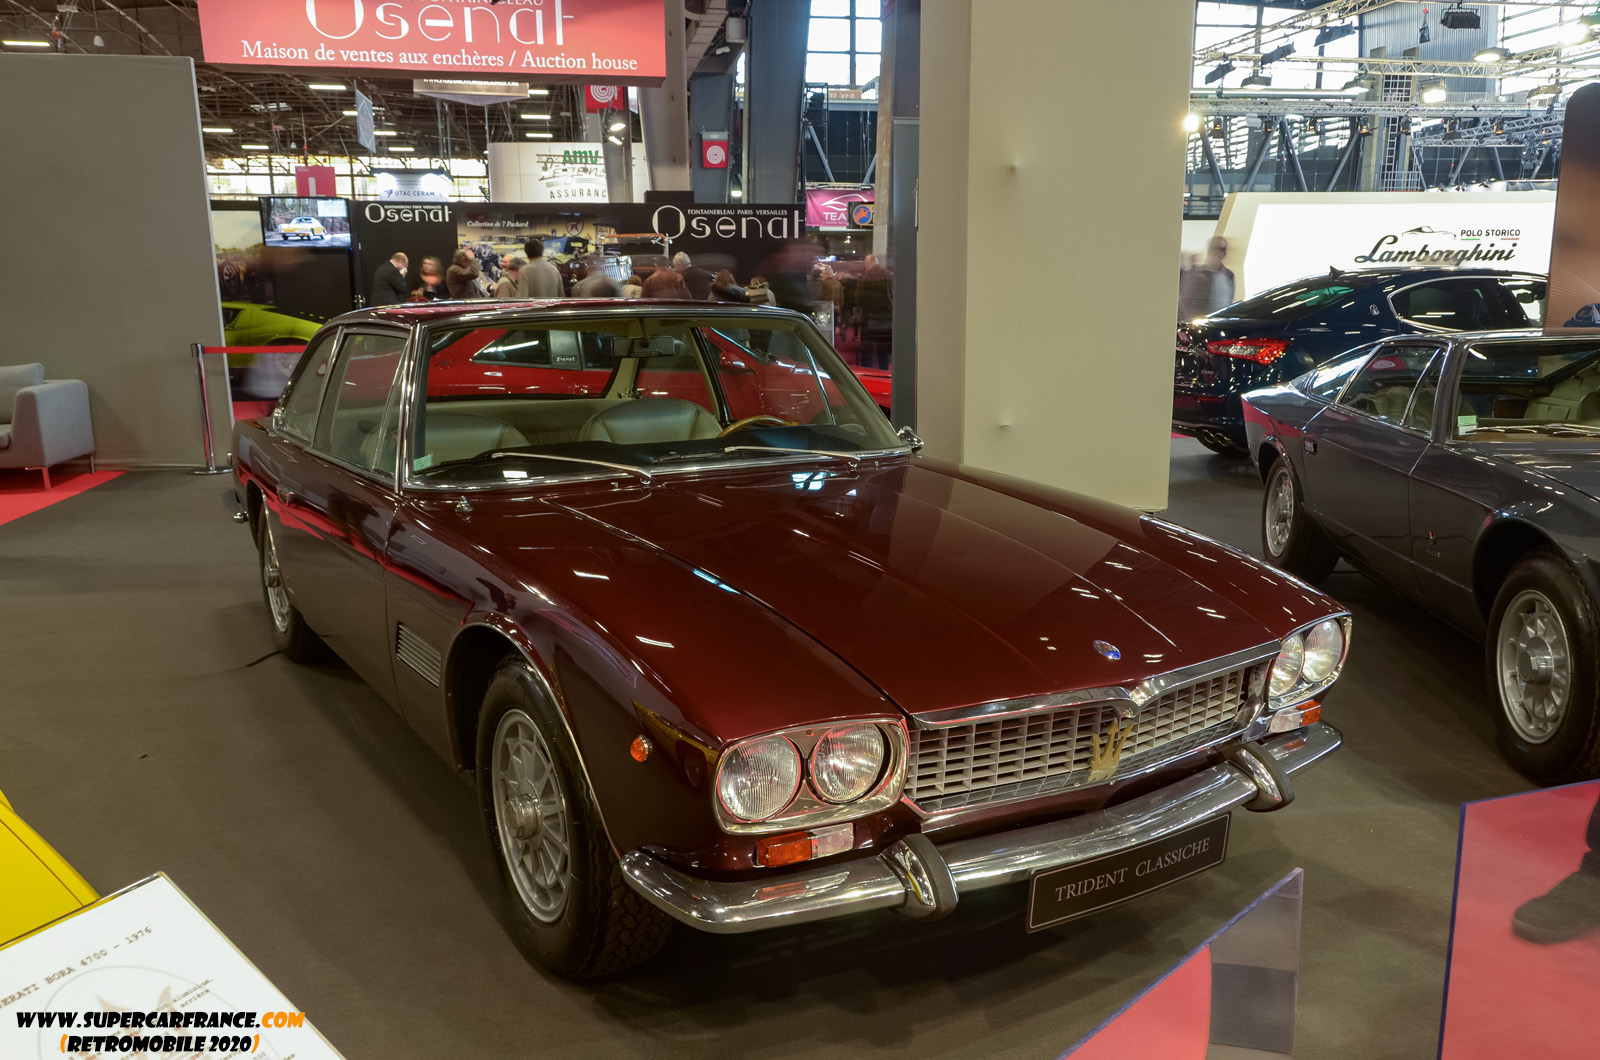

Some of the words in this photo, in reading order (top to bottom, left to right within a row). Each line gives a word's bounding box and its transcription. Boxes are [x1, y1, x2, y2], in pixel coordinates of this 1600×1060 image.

[305, 0, 574, 45] Osenat
[241, 40, 309, 60] Maison
[315, 43, 335, 61] de
[340, 48, 393, 63] ventes
[399, 52, 427, 64] aux
[433, 48, 504, 67] enchères
[508, 50, 517, 67] /
[521, 50, 587, 69] Auction
[591, 53, 638, 70] house
[550, 188, 607, 199] ASSURANC
[365, 203, 453, 223] Osenat
[467, 220, 494, 228] Collection
[494, 220, 501, 228] de
[506, 220, 529, 228] Packard
[652, 205, 807, 239] Osenat
[823, 212, 847, 221] TEA
[1460, 229, 1483, 237] POLO
[1485, 229, 1521, 237] STORICO
[1354, 234, 1518, 266] Lamborghini
[1055, 867, 1128, 902] TRIDENT
[1135, 837, 1210, 877] CLASSICHE
[0, 983, 40, 1009] ERATI
[44, 966, 76, 984] BORA
[80, 949, 108, 967] 4700
[125, 925, 152, 944] 1976
